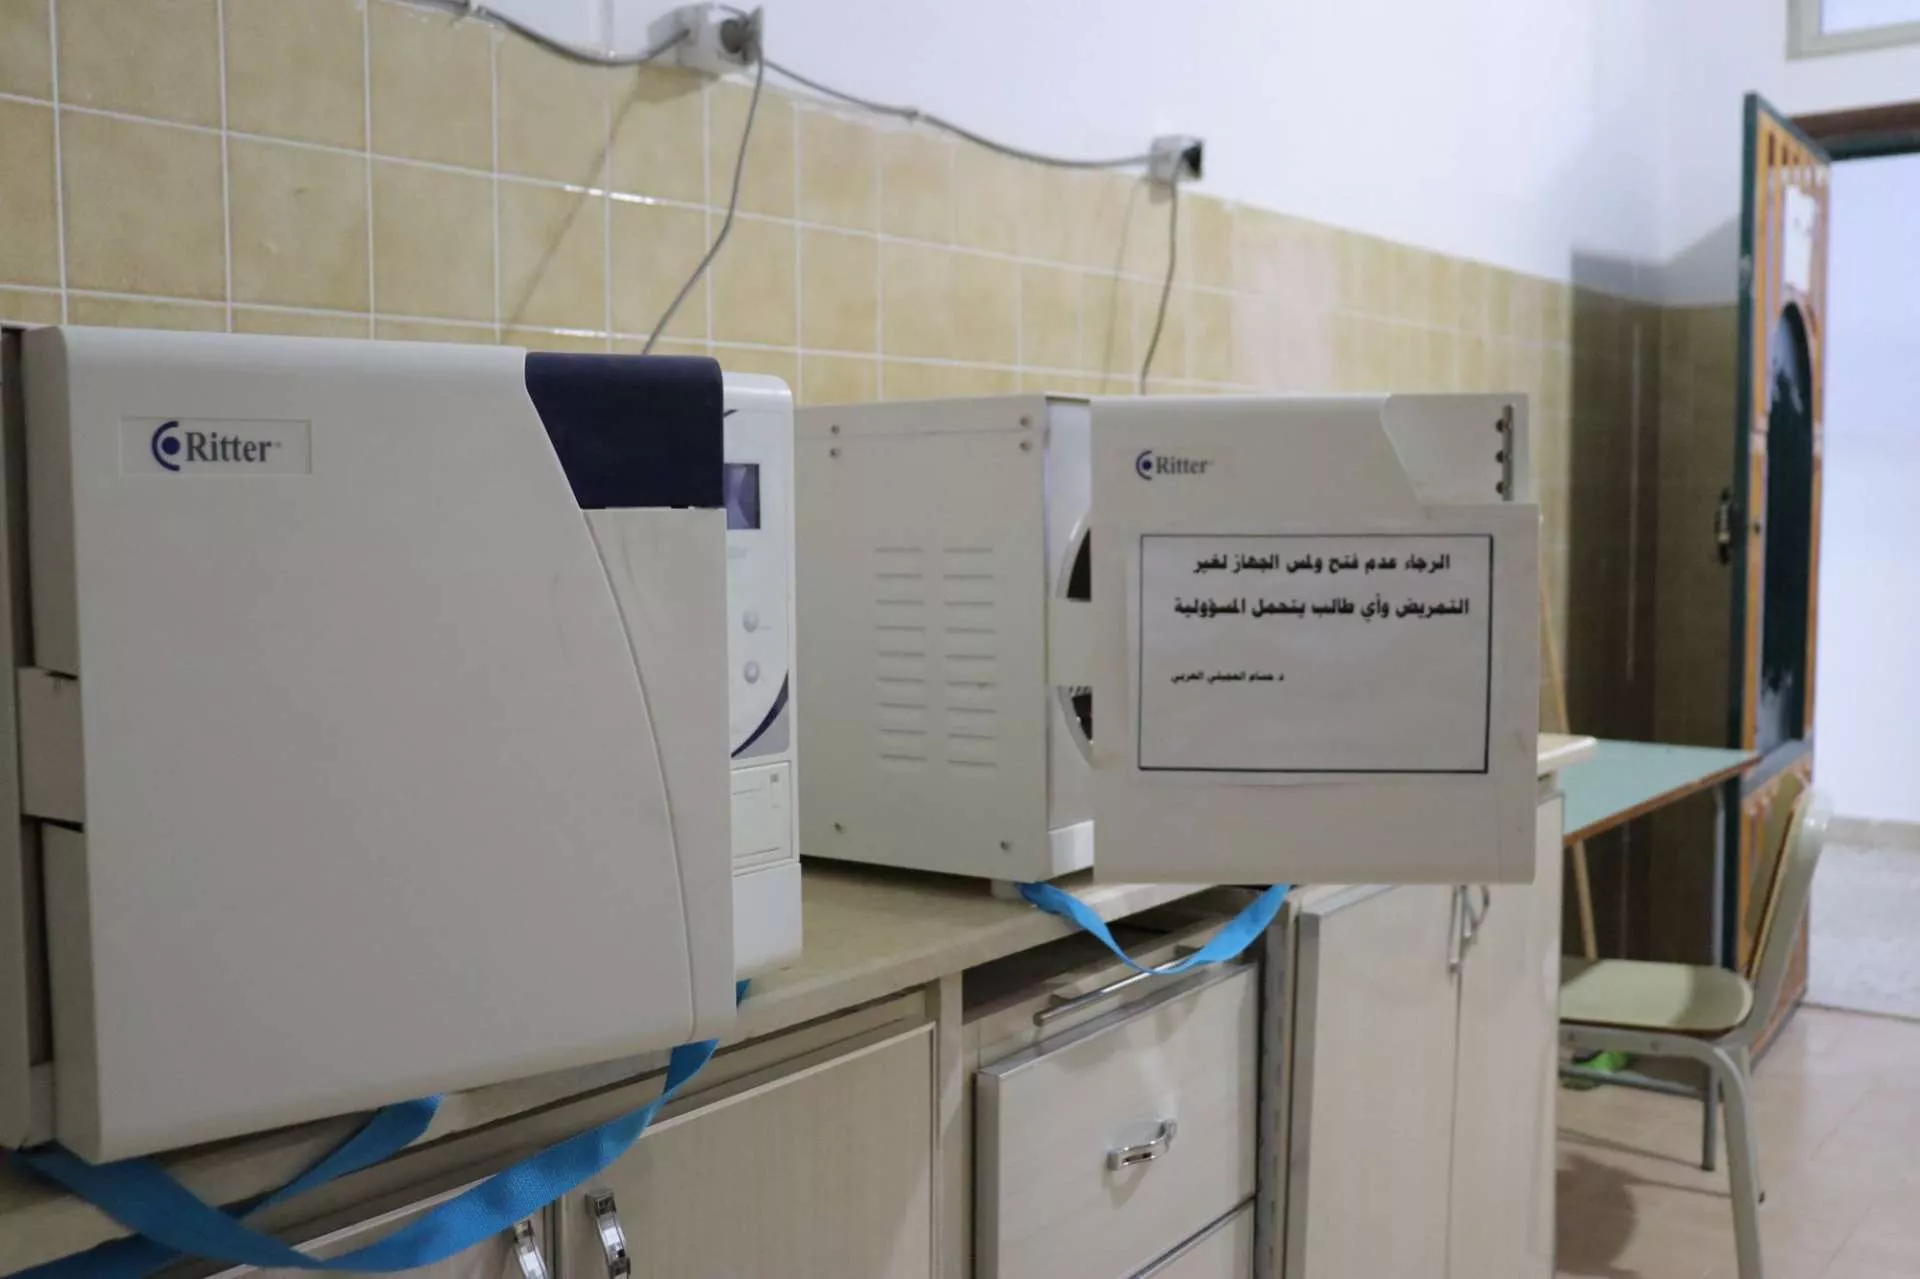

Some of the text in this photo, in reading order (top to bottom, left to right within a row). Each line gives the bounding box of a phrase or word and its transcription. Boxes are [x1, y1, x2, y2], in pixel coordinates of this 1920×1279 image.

[184, 431, 273, 463] Ritter
[1155, 455, 1209, 475] Ritter
[1193, 553, 1451, 575] الرجاء عدم فتح ولمس الجهاز لغير
[1174, 593, 1470, 623] التمريض وأي طالب يتحمل المسؤولية
